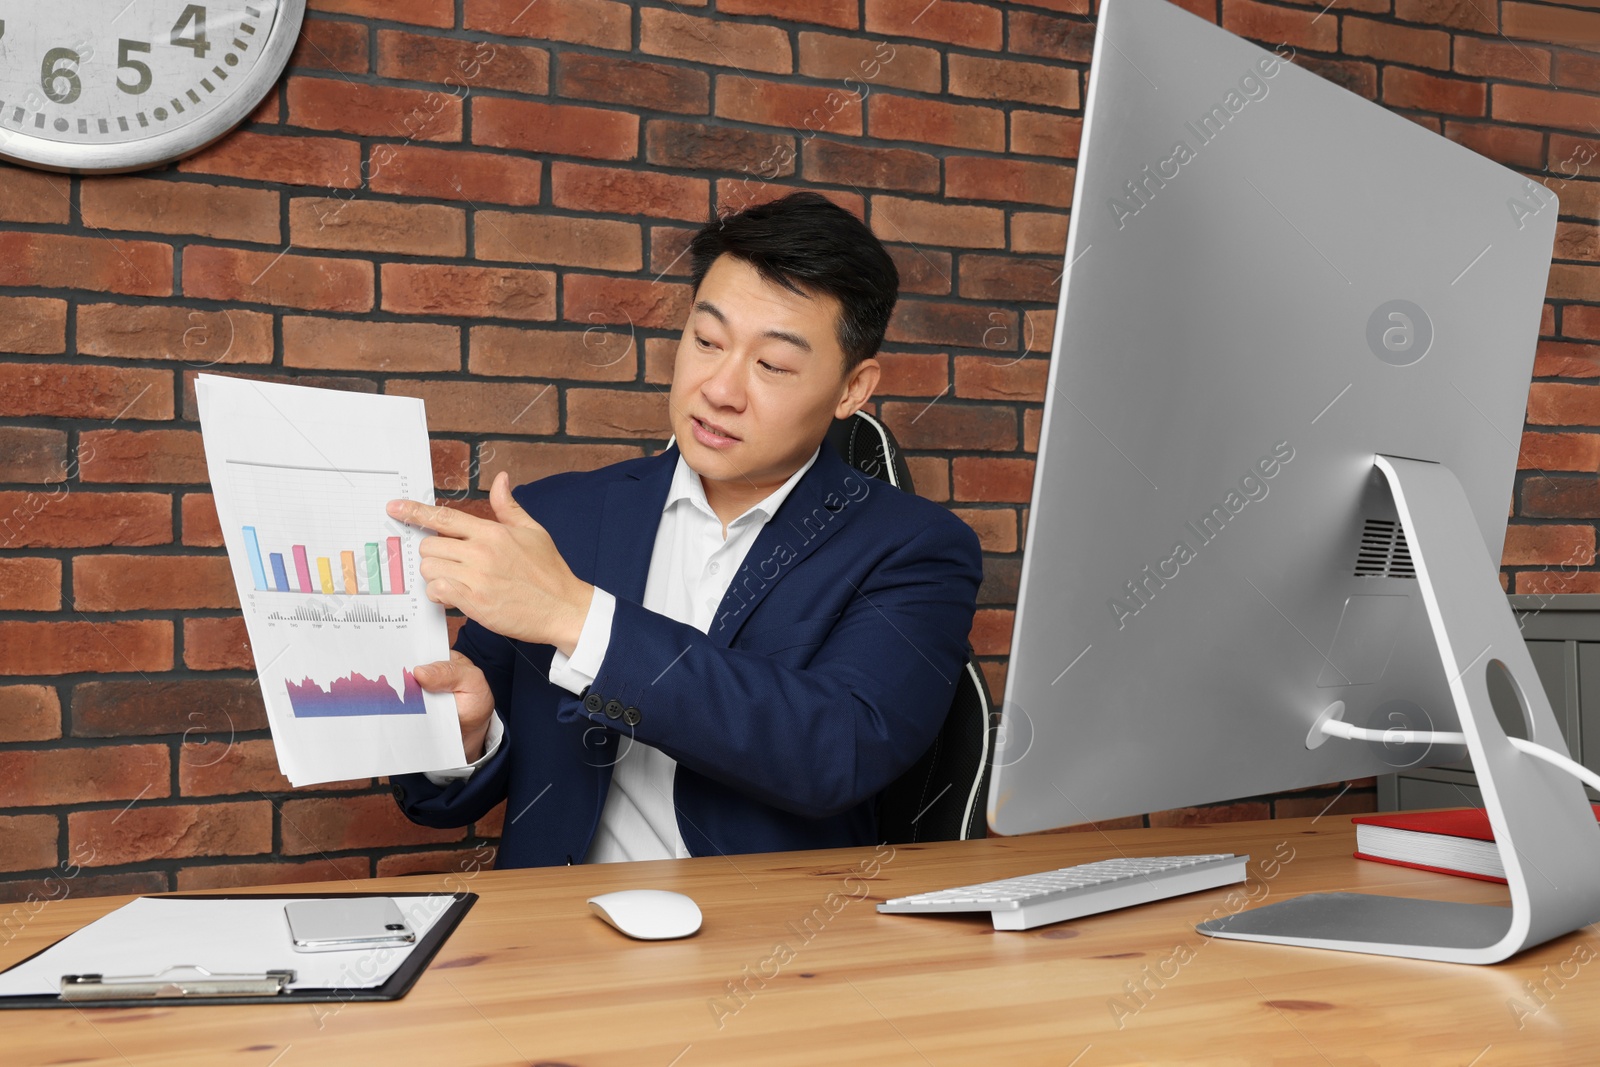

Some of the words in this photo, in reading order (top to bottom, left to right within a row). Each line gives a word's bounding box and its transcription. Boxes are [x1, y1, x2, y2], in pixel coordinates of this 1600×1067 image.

[170, 4, 211, 59] 4
[41, 47, 82, 105] 6
[116, 38, 153, 95] 5
